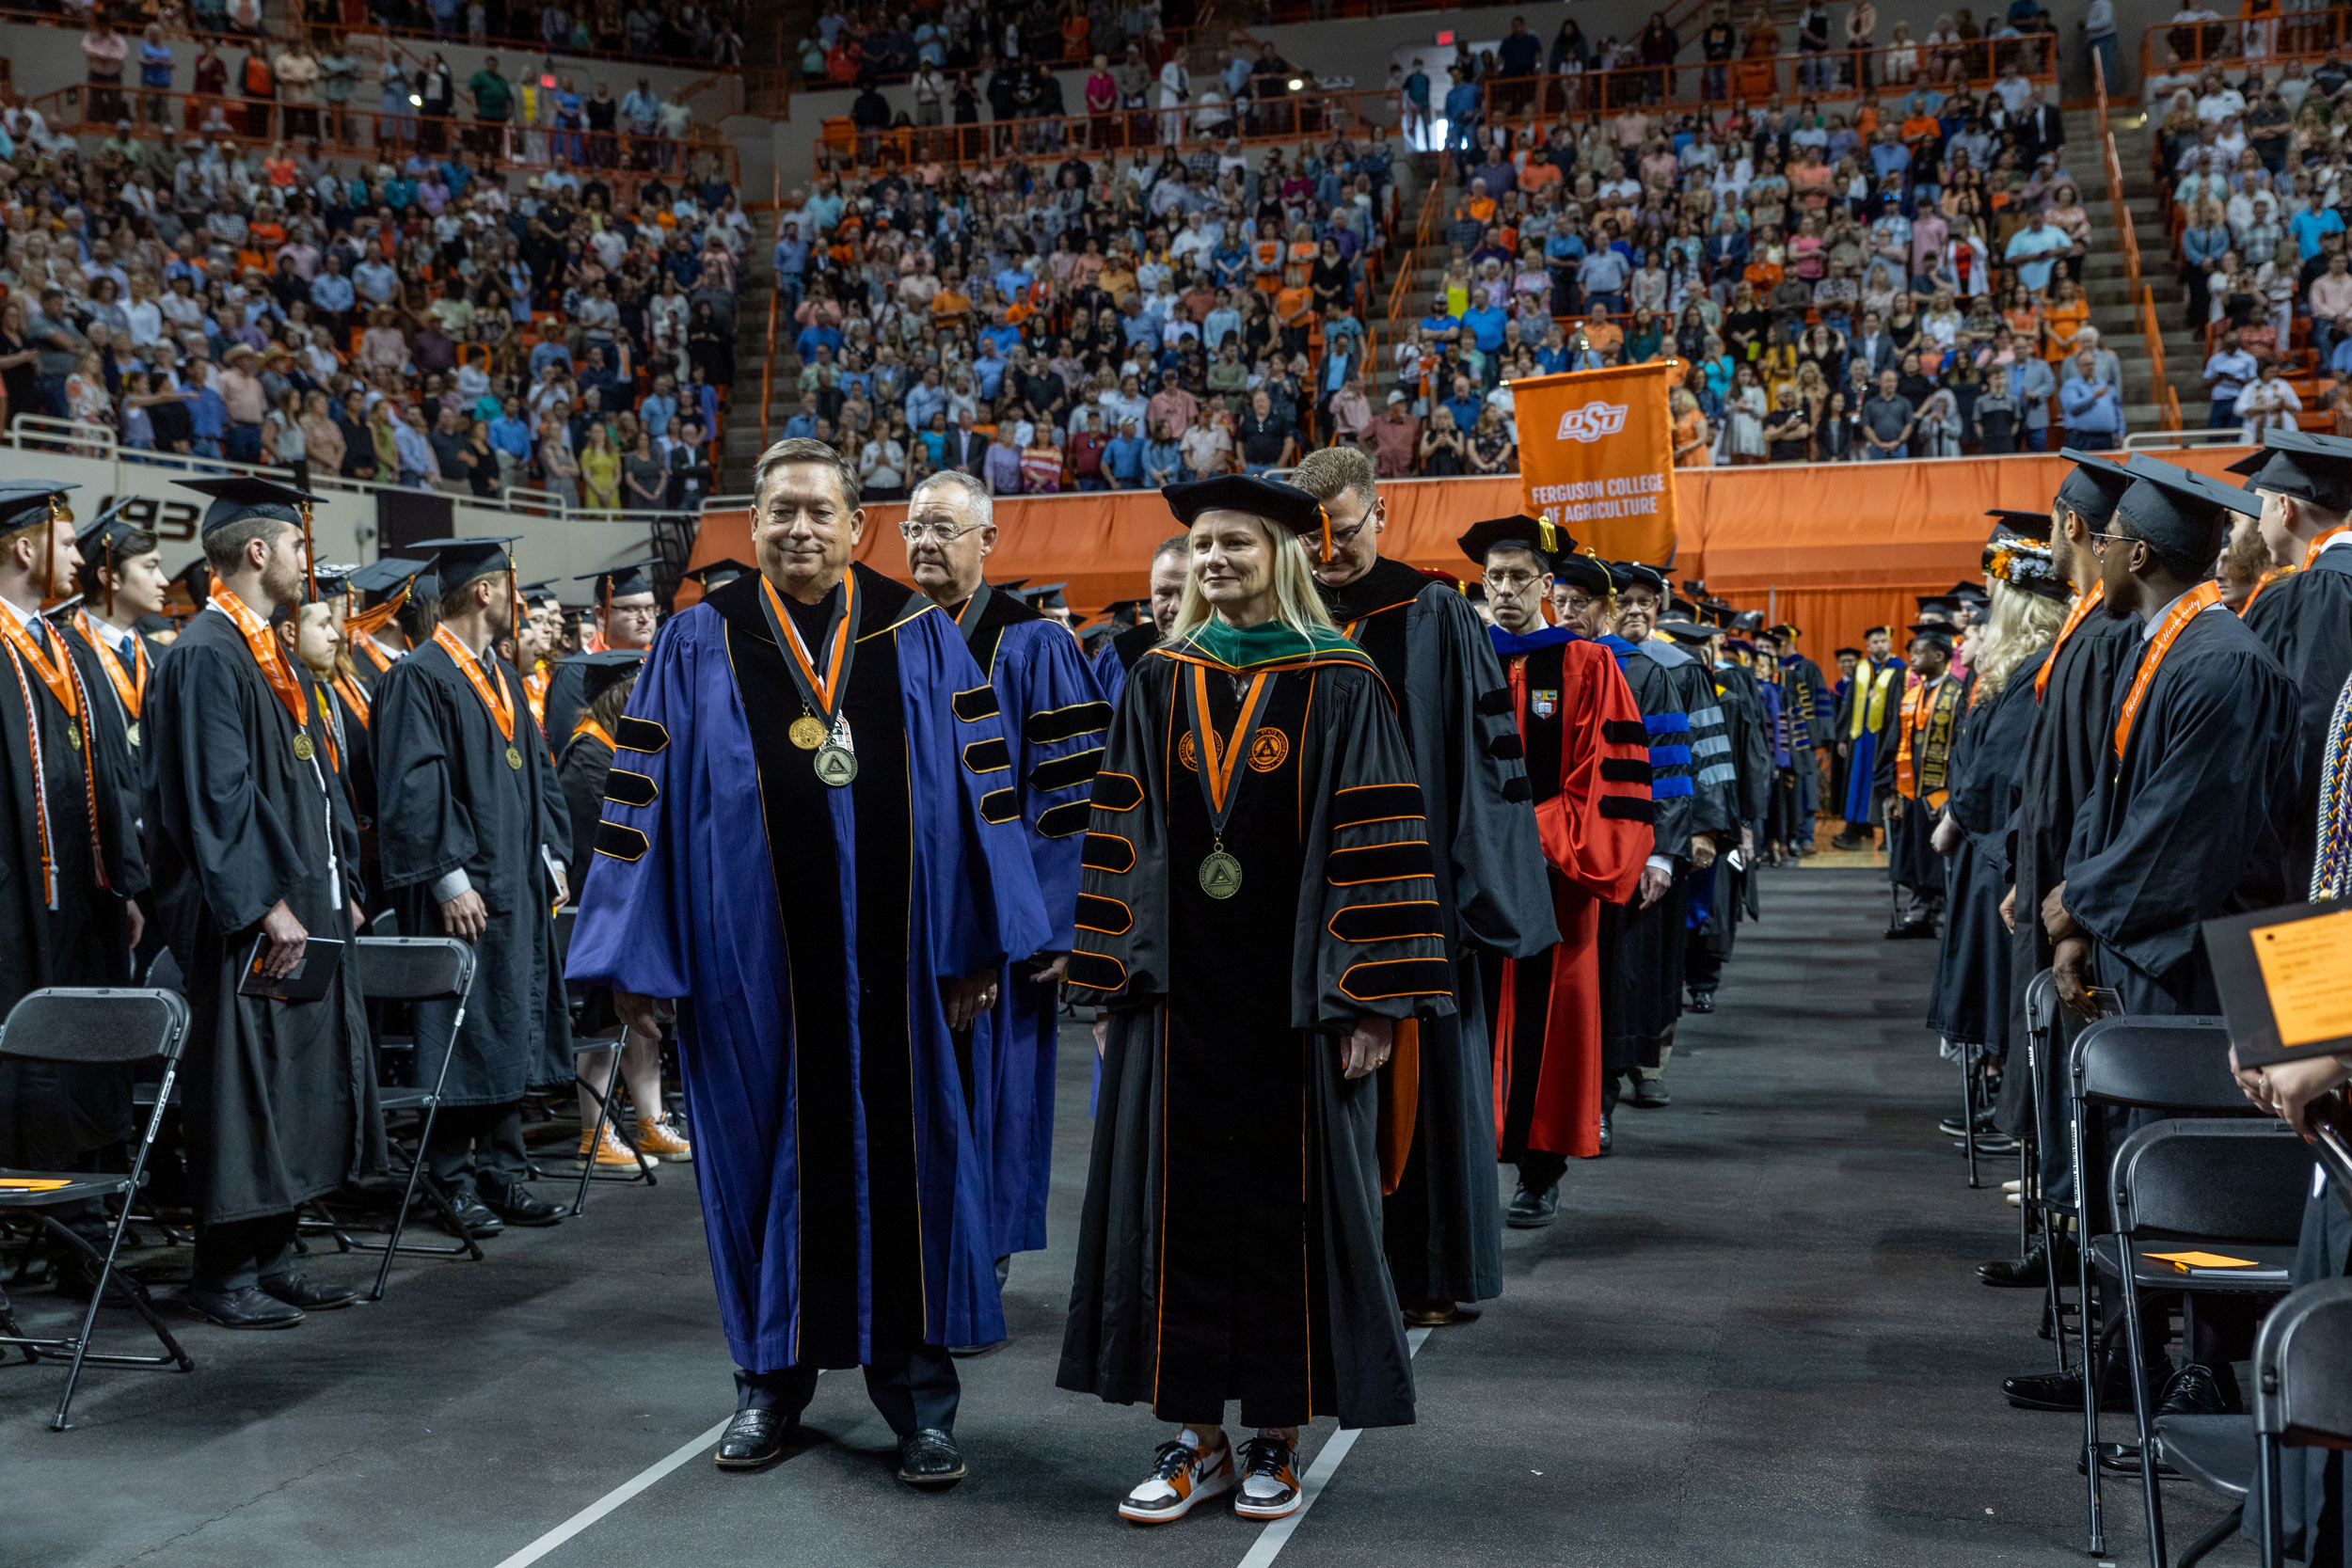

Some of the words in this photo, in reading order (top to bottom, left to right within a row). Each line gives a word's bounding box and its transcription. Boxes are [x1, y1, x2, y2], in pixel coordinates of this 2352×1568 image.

[1557, 401, 1629, 443] OSU
[1532, 479, 1603, 505] FERGUSON
[1607, 473, 1664, 498] COLLEGE
[1543, 506, 1560, 524] OF
[1565, 496, 1658, 523] AGRICULTURE
